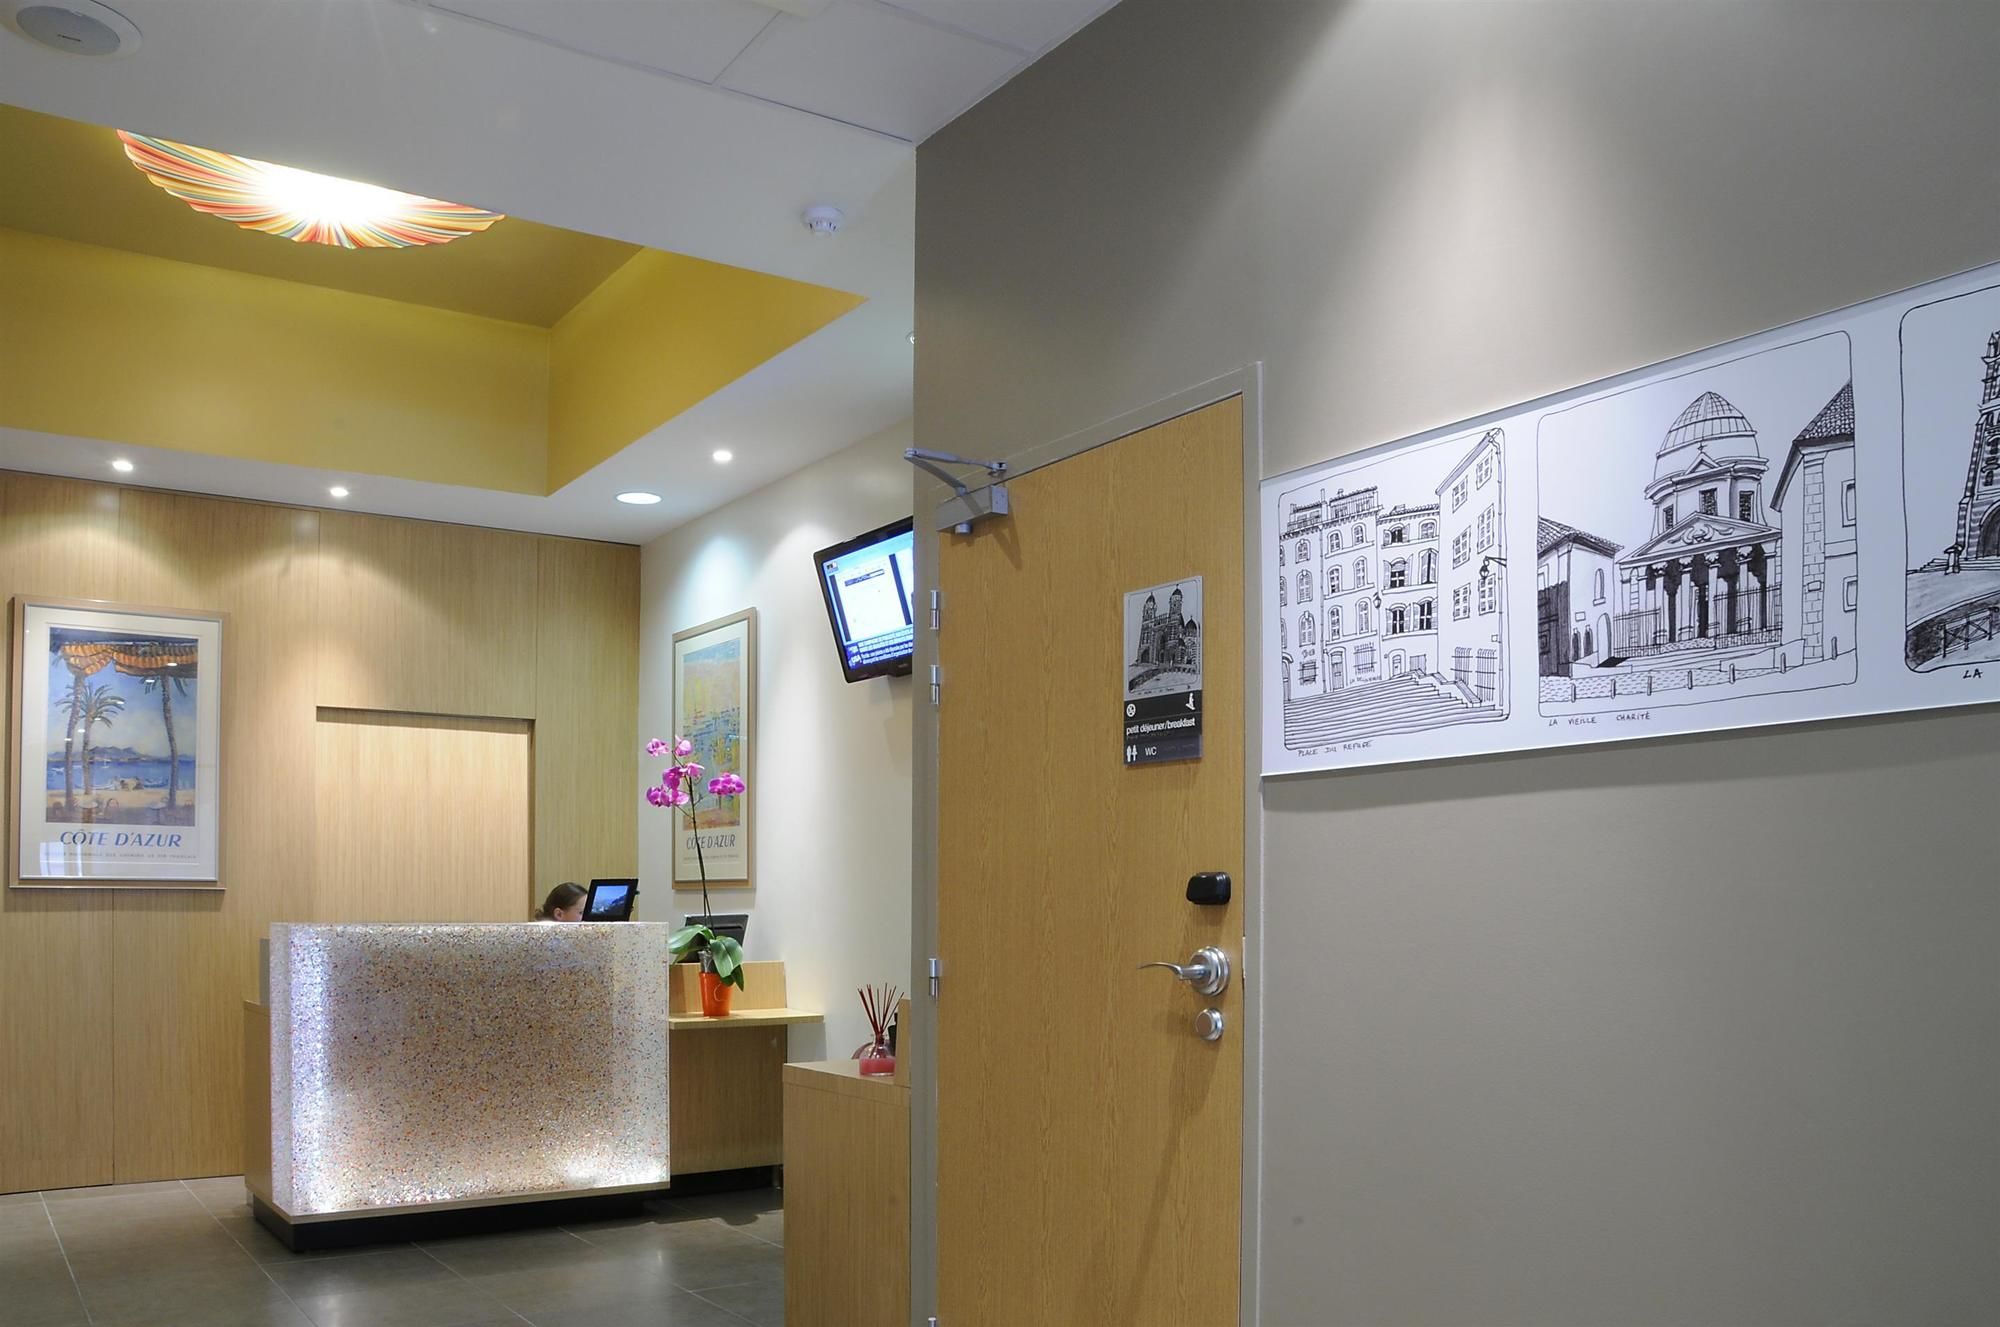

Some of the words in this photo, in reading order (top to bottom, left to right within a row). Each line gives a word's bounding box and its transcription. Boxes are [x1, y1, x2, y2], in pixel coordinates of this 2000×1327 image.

[1963, 668, 1983, 679] LA
[1126, 725, 1140, 736] petit
[1145, 746, 1157, 756] WC
[60, 829, 109, 846] CÔTE
[114, 832, 182, 848] D'AZUR
